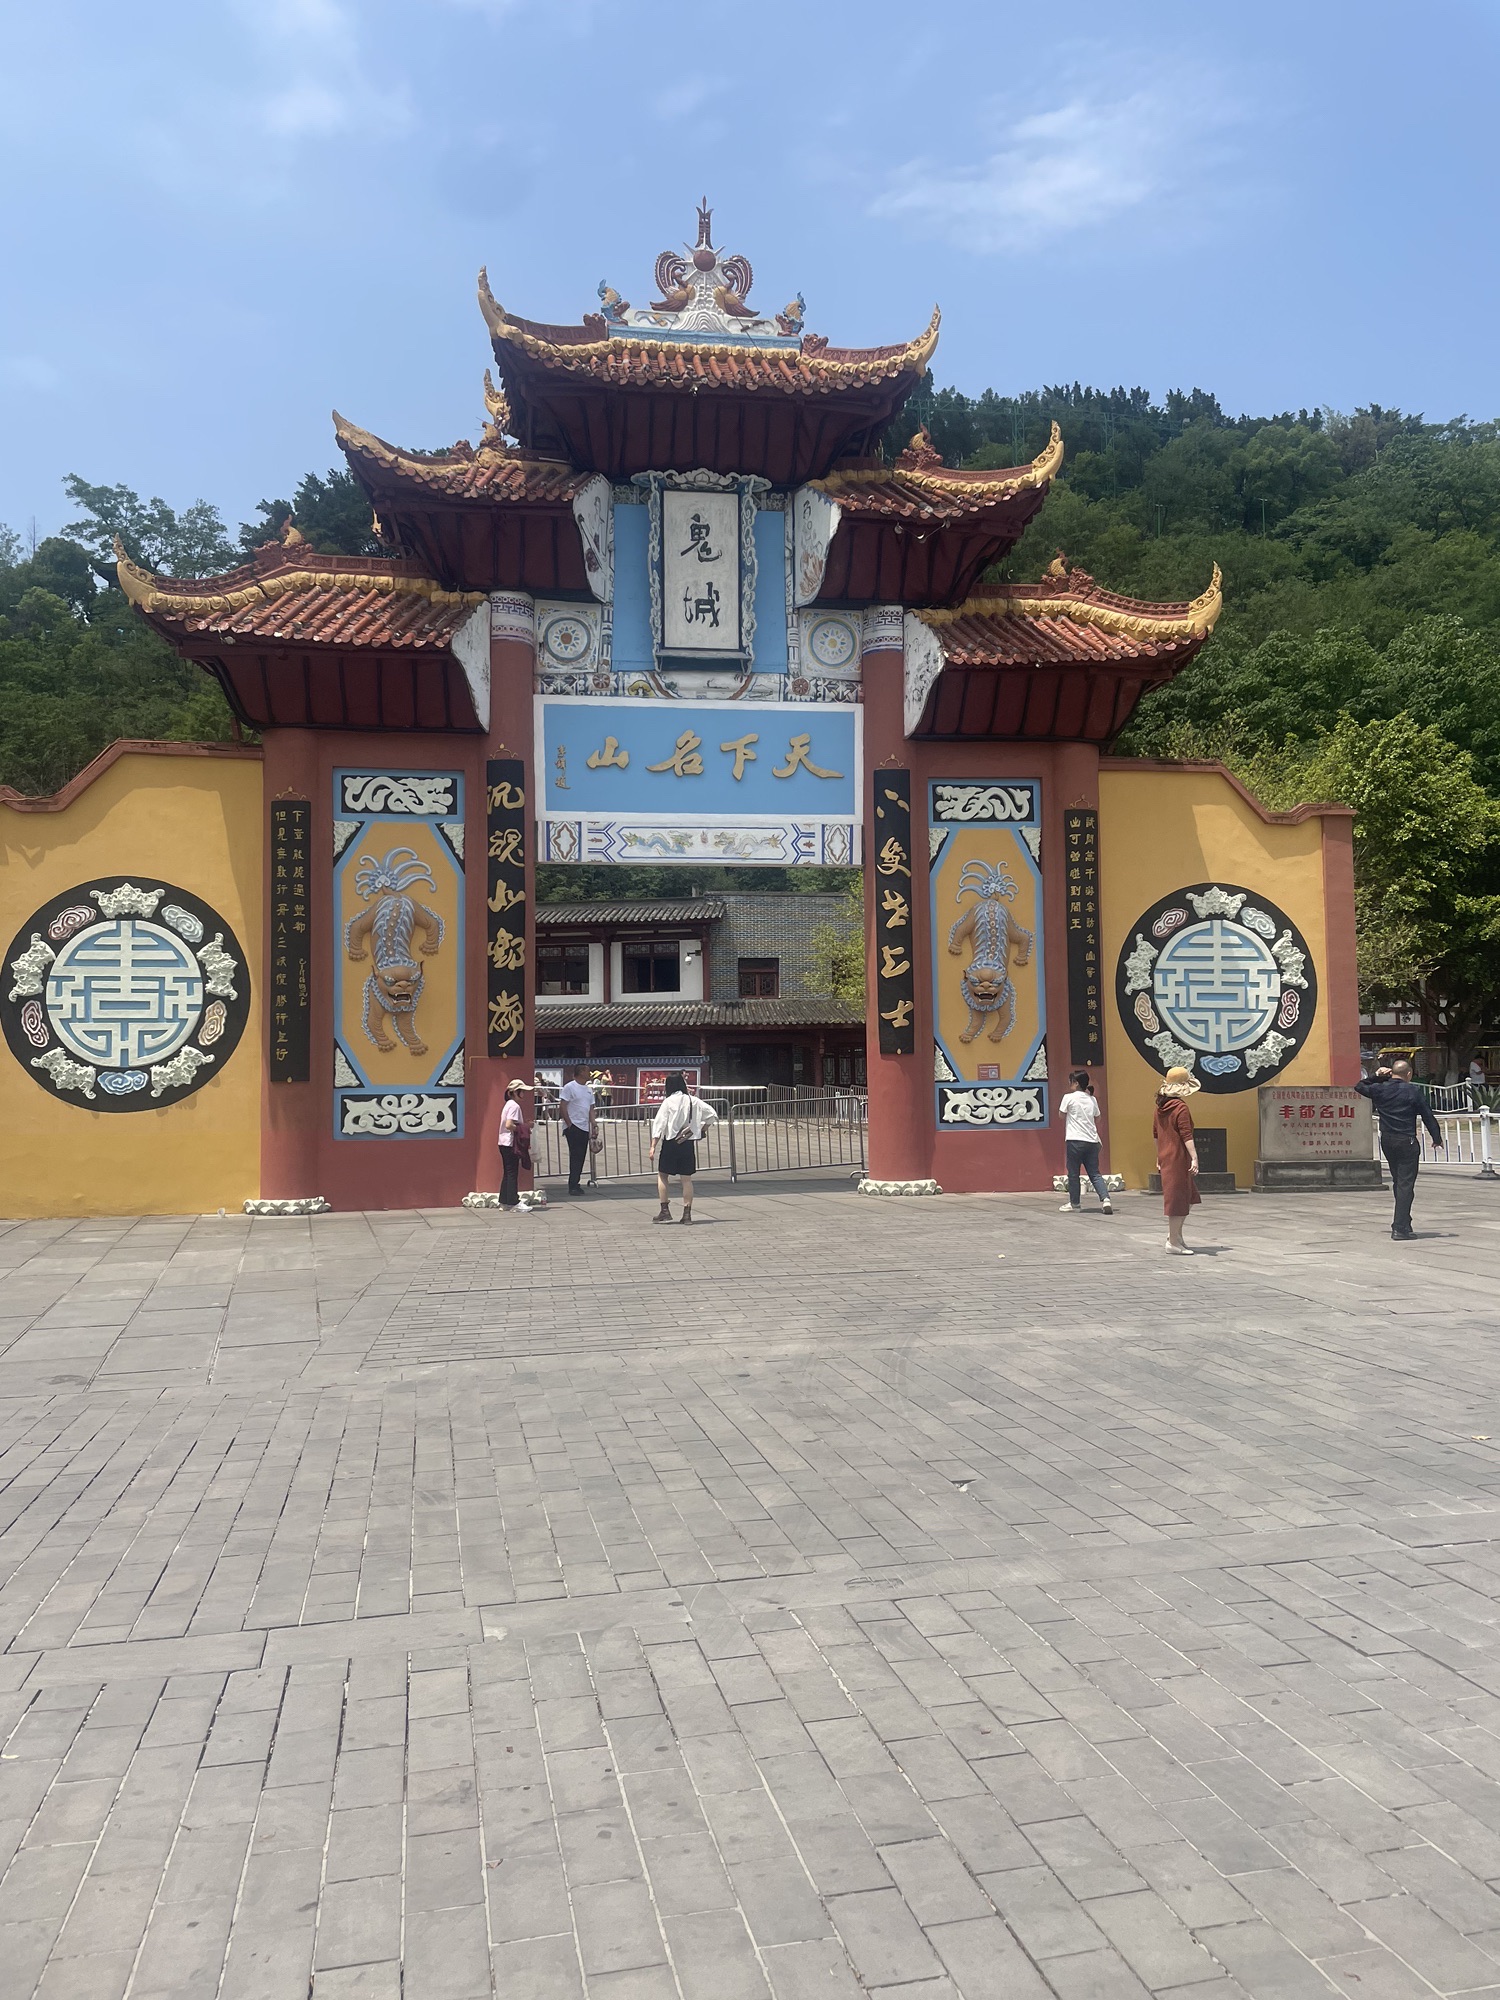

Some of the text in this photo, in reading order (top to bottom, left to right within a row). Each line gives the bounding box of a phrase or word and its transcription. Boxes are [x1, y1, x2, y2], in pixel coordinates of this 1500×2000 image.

[681, 513, 722, 627] 鬼城
[586, 730, 844, 781] 天下名山
[1279, 1105, 1355, 1118] 丰都名山
